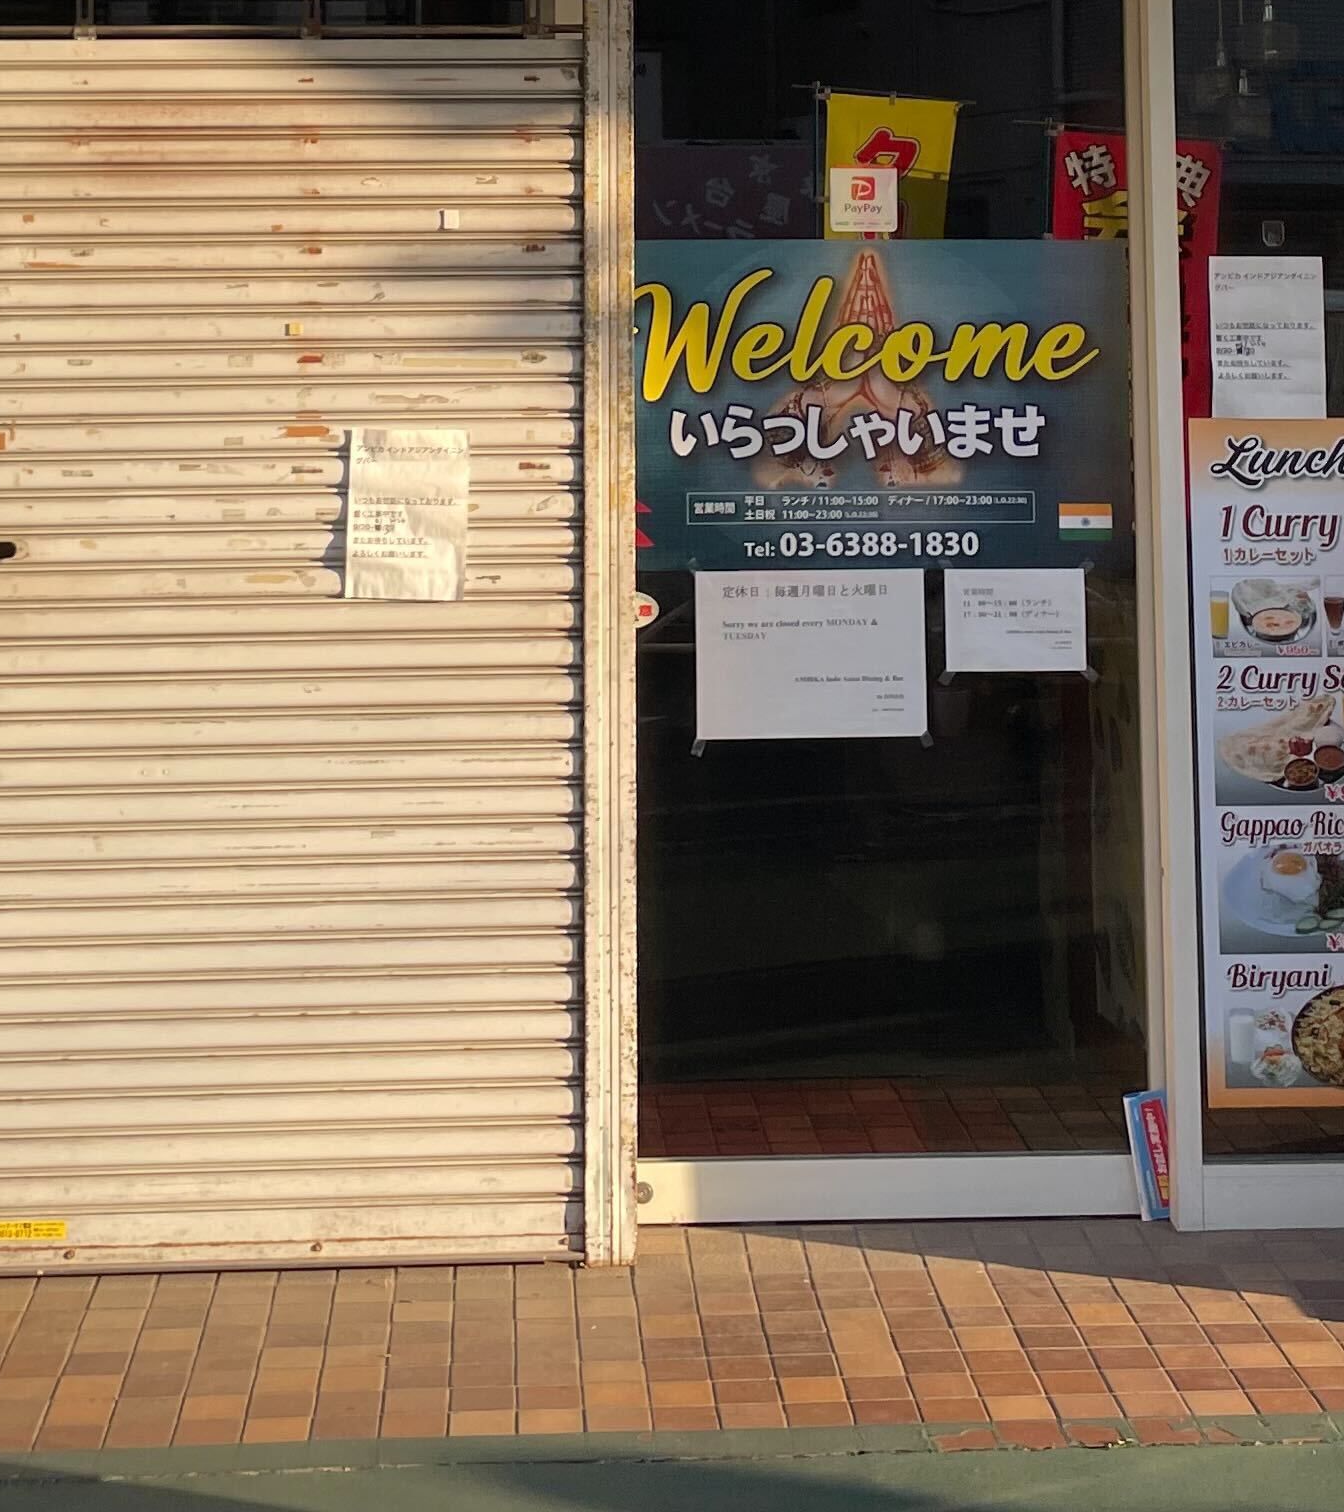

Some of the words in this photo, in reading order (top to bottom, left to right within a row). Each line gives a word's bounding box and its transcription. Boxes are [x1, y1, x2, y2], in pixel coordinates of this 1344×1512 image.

[844, 203, 883, 215] PayPay
[634, 267, 1099, 402] Welcome
[669, 404, 1046, 461] いらっしゃいませ
[744, 495, 765, 507] 平日
[781, 495, 810, 507] ランチ
[744, 509, 776, 521] 土日祝
[1220, 504, 1237, 540] 1
[1241, 504, 1342, 550] Curry
[744, 541, 776, 558] Tel:
[779, 531, 979, 558] 03-6388-1830
[1223, 547, 1316, 564] 1カレーセット
[1217, 666, 1233, 691] 2
[1240, 665, 1318, 696] Curry
[1220, 811, 1304, 846] Gappao
[1227, 963, 1332, 996] Biryani
